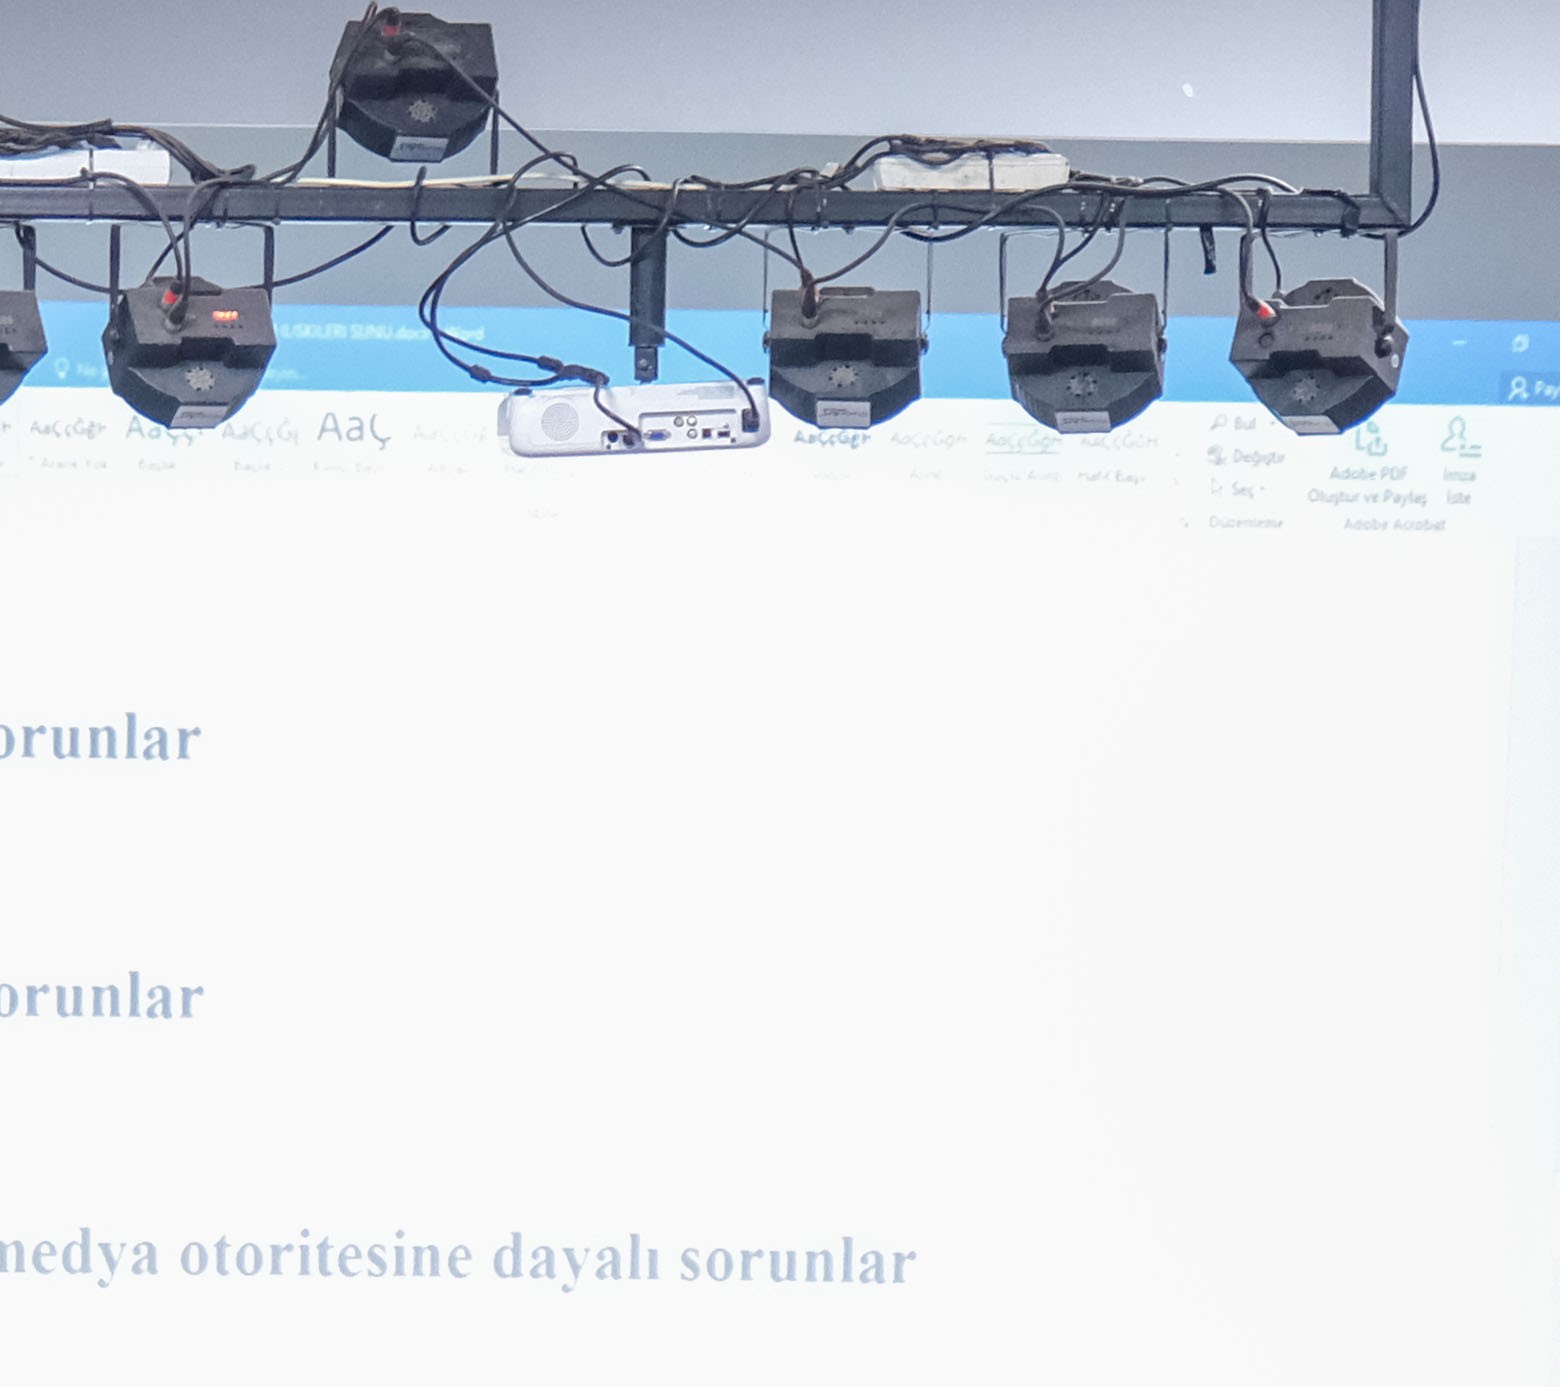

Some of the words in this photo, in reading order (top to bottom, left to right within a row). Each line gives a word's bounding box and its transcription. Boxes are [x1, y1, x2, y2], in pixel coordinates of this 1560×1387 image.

[1329, 466, 1376, 481] Adobe
[1380, 466, 1409, 481] PDF
[1343, 517, 1388, 532] Adobe
[180, 1228, 472, 1278] otoritesine
[493, 1232, 659, 1293] dayalı
[681, 1236, 917, 1284] sorunlar
